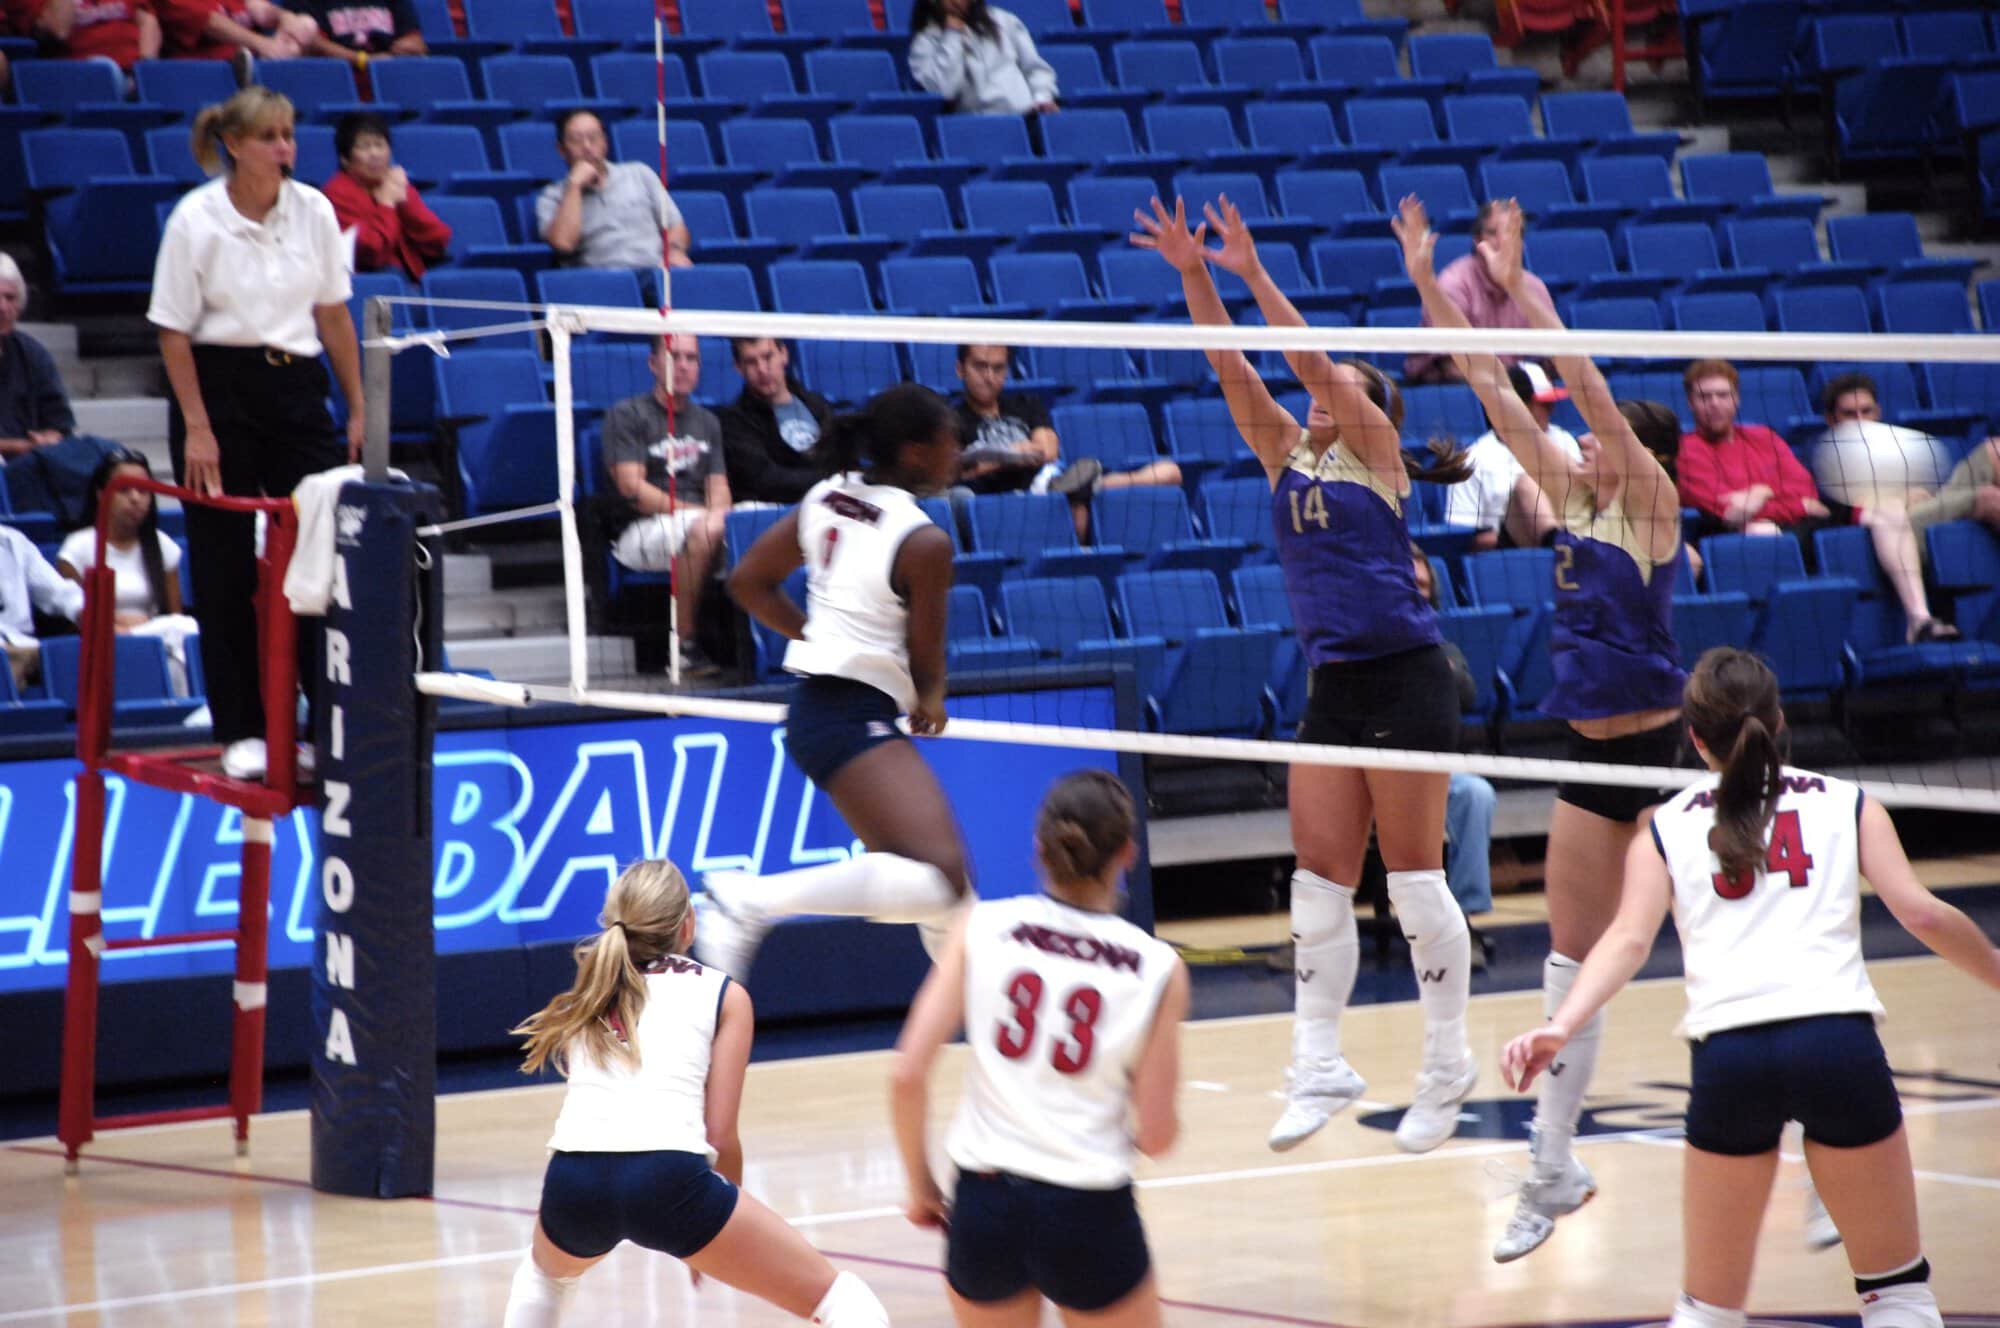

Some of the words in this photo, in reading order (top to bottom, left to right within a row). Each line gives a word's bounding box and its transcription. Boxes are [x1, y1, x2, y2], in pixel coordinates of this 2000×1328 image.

[1288, 484, 1329, 534] 14
[1554, 544, 1580, 590] 2
[324, 552, 357, 1067] ARIZONA
[995, 969, 1105, 1076] 33
